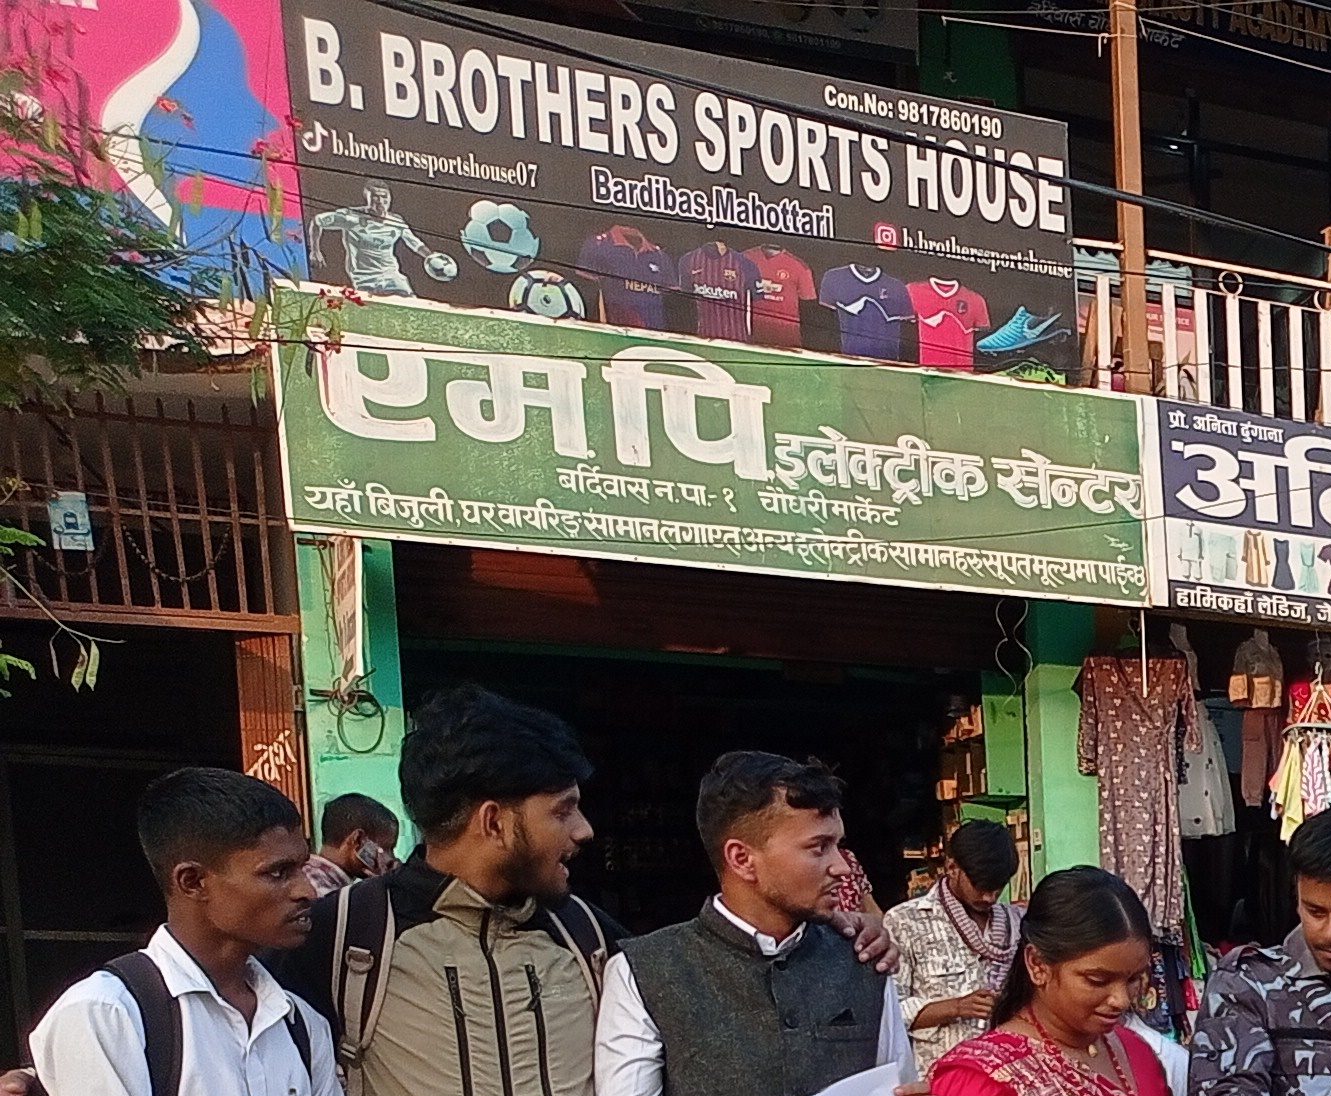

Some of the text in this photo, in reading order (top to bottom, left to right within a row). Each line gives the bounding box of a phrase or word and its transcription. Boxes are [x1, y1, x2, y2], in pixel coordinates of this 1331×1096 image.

[302, 17, 1066, 233] B. BROTHERS SPORTS HOUSE
[824, 85, 1002, 139] Con.No: 9817860190
[331, 130, 538, 189] b.brotherssportshouse07
[1193, 415, 1237, 437] अनिता
